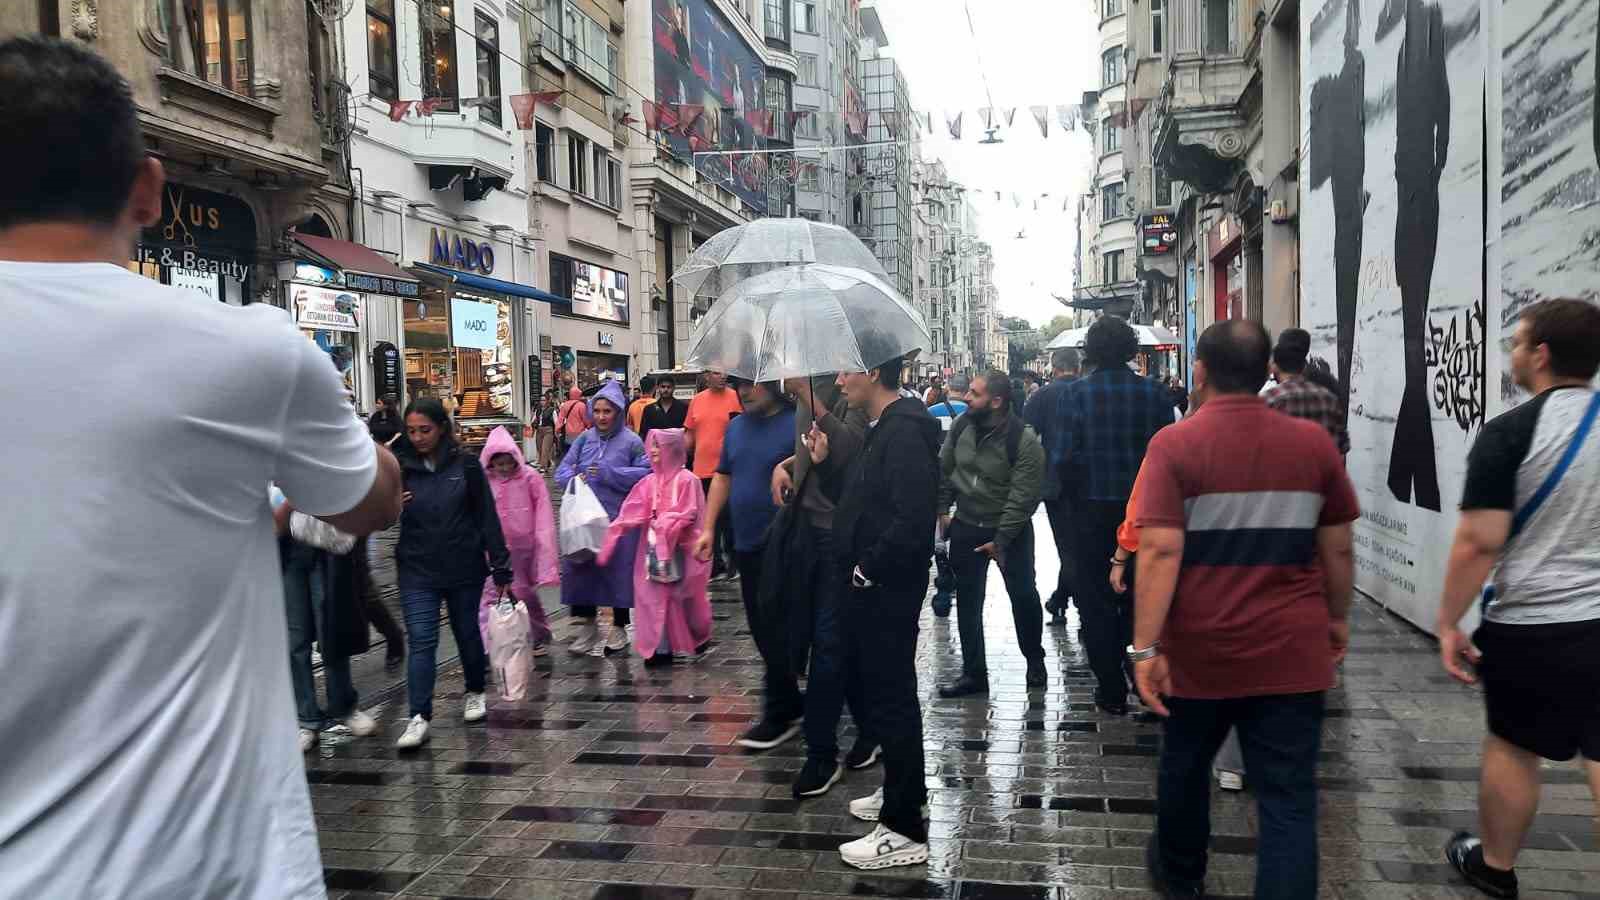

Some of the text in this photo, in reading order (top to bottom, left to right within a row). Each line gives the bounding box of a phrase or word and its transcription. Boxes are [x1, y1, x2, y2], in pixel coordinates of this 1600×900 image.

[161, 247, 176, 266] &
[184, 250, 248, 282] Beauty
[430, 226, 495, 275] MADO
[464, 319, 488, 332] MADO
